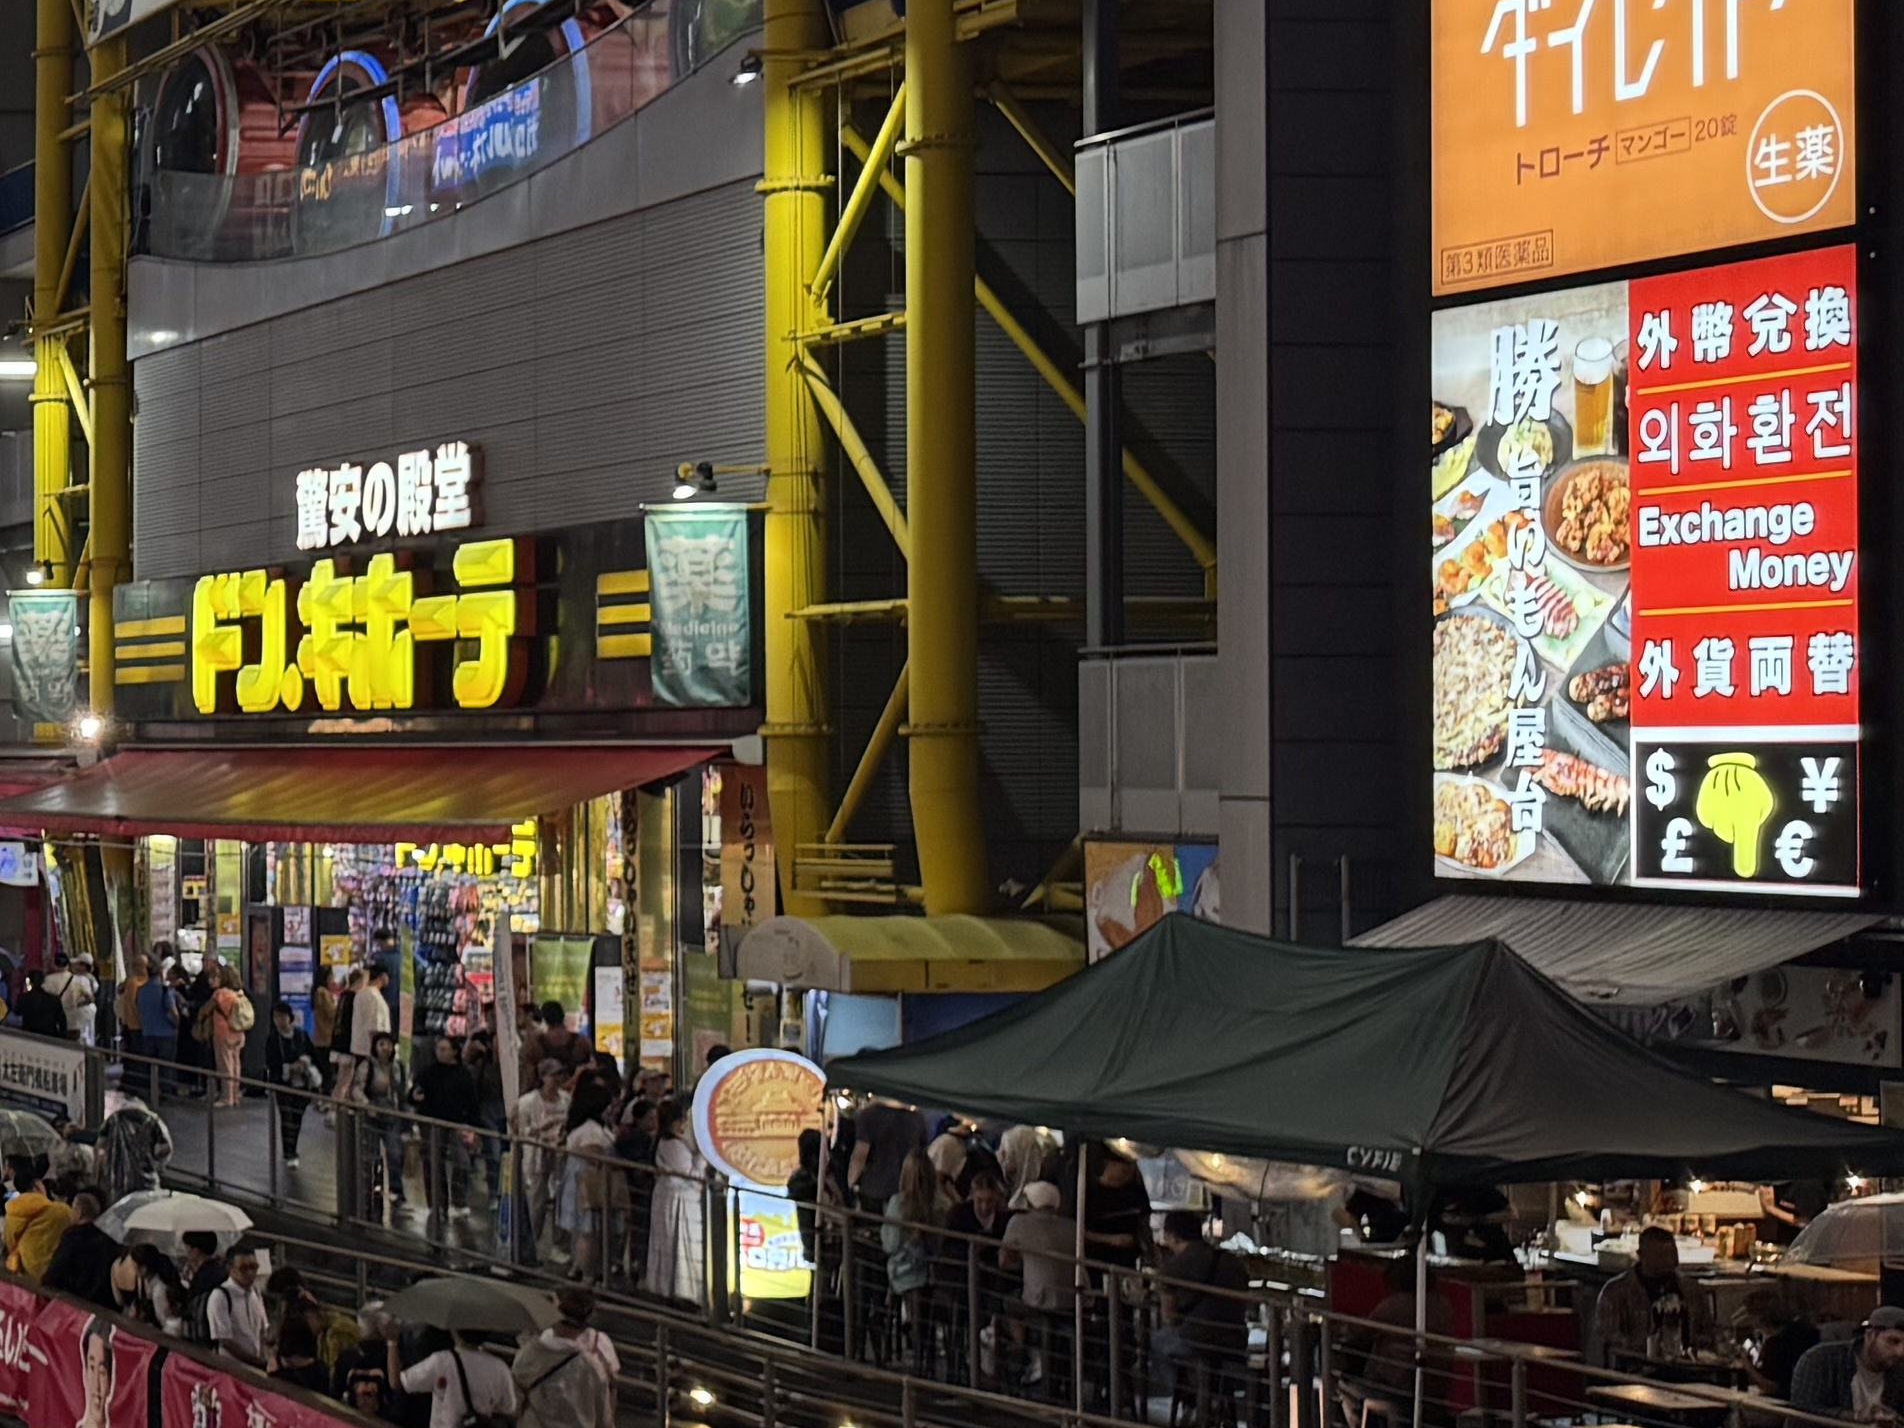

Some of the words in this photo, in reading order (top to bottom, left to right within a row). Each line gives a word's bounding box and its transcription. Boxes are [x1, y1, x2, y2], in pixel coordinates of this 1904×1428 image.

[1515, 135, 1611, 186] トローチ
[1620, 124, 1686, 158] マンゴー
[1695, 113, 1738, 144] 20錠
[1754, 123, 1835, 189] 生薬
[1442, 234, 1552, 281] 第3類医薬品
[1488, 317, 1562, 427] 勝
[1637, 381, 1852, 475] 외화환전
[296, 440, 473, 551] 驚安の殿堂
[1638, 501, 1815, 547] Exchange
[1728, 548, 1854, 593] Money
[1638, 632, 1855, 699] 外貨両替
[1645, 747, 1677, 813] $
[1800, 757, 1841, 814] ¥
[1660, 818, 1695, 874] £
[1774, 819, 1815, 878] €
